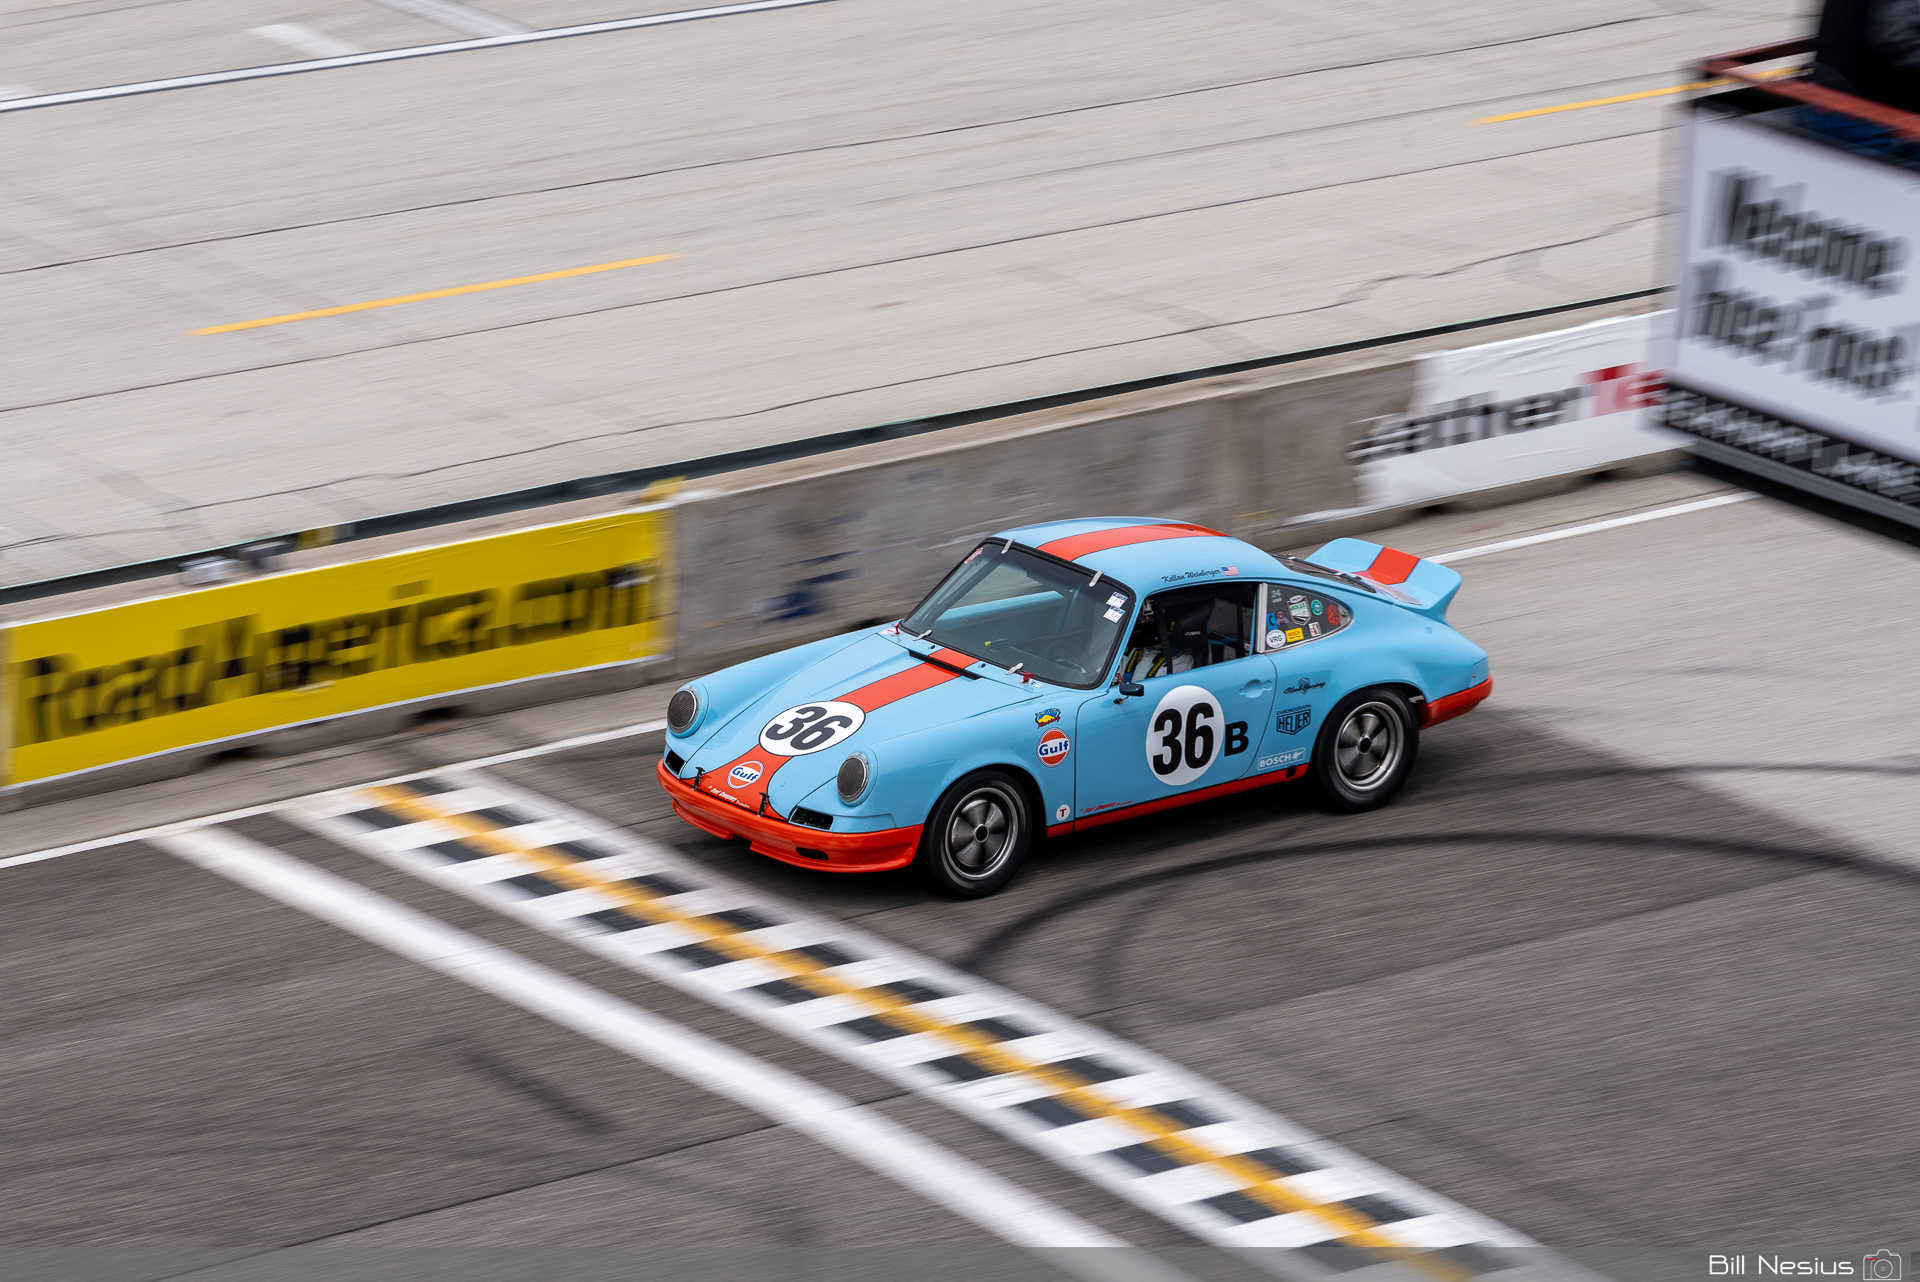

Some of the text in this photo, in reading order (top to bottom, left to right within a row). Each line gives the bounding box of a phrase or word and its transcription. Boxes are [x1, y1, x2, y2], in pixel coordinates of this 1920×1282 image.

[1268, 634, 1283, 643] VRG
[17, 563, 654, 746] RoadAmerica.com
[765, 705, 853, 751] 36
[1278, 711, 1309, 733] HEUER
[1152, 702, 1215, 776] 36
[1224, 720, 1249, 757] B
[1039, 740, 1069, 757] Gulf
[1258, 753, 1292, 768] BOSCH
[731, 766, 759, 783] Gulf
[1059, 808, 1067, 817] T
